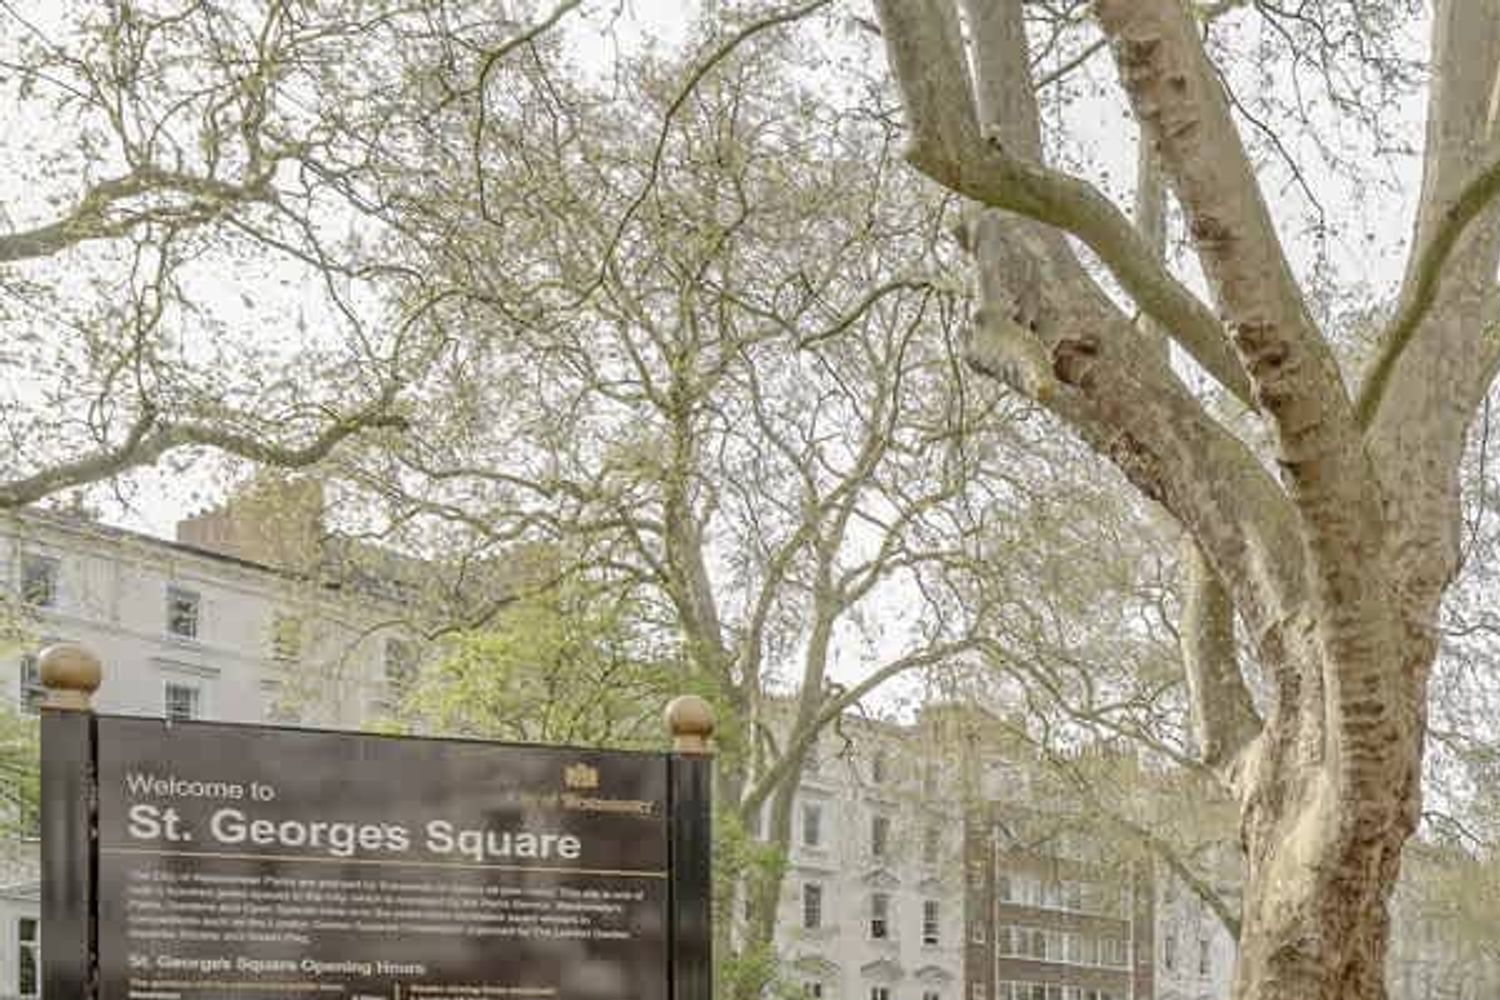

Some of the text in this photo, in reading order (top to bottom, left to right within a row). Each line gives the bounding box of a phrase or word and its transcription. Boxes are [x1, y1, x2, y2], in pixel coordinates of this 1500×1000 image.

[127, 773, 275, 800] Welcome to
[128, 804, 192, 842] St.
[425, 820, 583, 862] Square
[237, 957, 298, 974] Square
[301, 959, 371, 977] Opening
